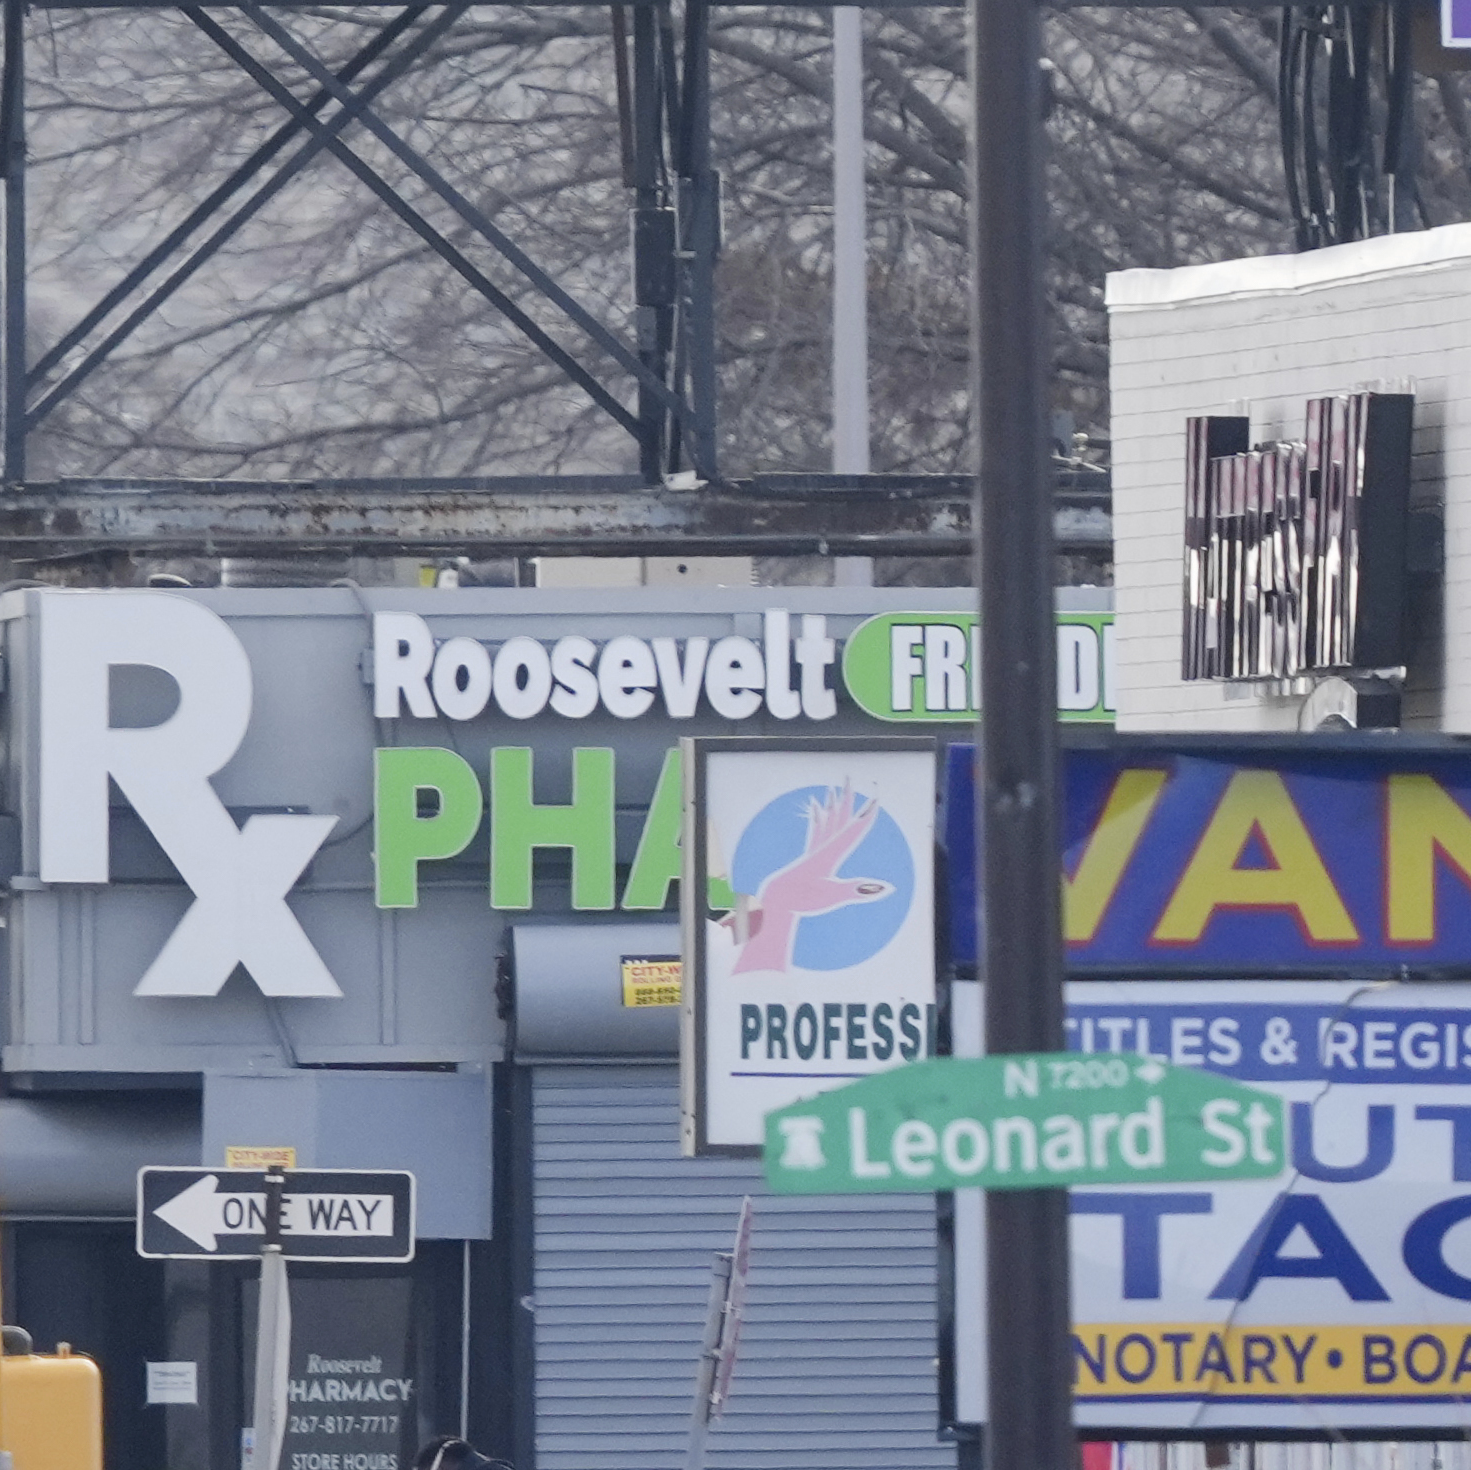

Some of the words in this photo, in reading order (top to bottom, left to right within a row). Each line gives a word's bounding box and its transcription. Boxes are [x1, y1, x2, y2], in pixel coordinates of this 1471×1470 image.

[372, 608, 838, 721] Roosevelt
[891, 623, 981, 712] FR
[40, 587, 344, 998] Rx
[740, 1003, 936, 1061] PROFESSI
[1260, 1016, 1298, 1065] &
[1319, 1017, 1471, 1070] REGI
[1003, 1060, 1039, 1097] N
[1046, 1060, 1129, 1089] 7200
[849, 1096, 1166, 1179] Leonard
[1201, 1098, 1276, 1168] St
[223, 1198, 292, 1229] ONE
[309, 1199, 380, 1230] WAY
[1070, 1332, 1318, 1384] NOTARY
[289, 1379, 413, 1402] HARMACY
[290, 1415, 399, 1434] 267-817-7717
[292, 1453, 341, 1470] STORE
[343, 1453, 398, 1470] HOURS
